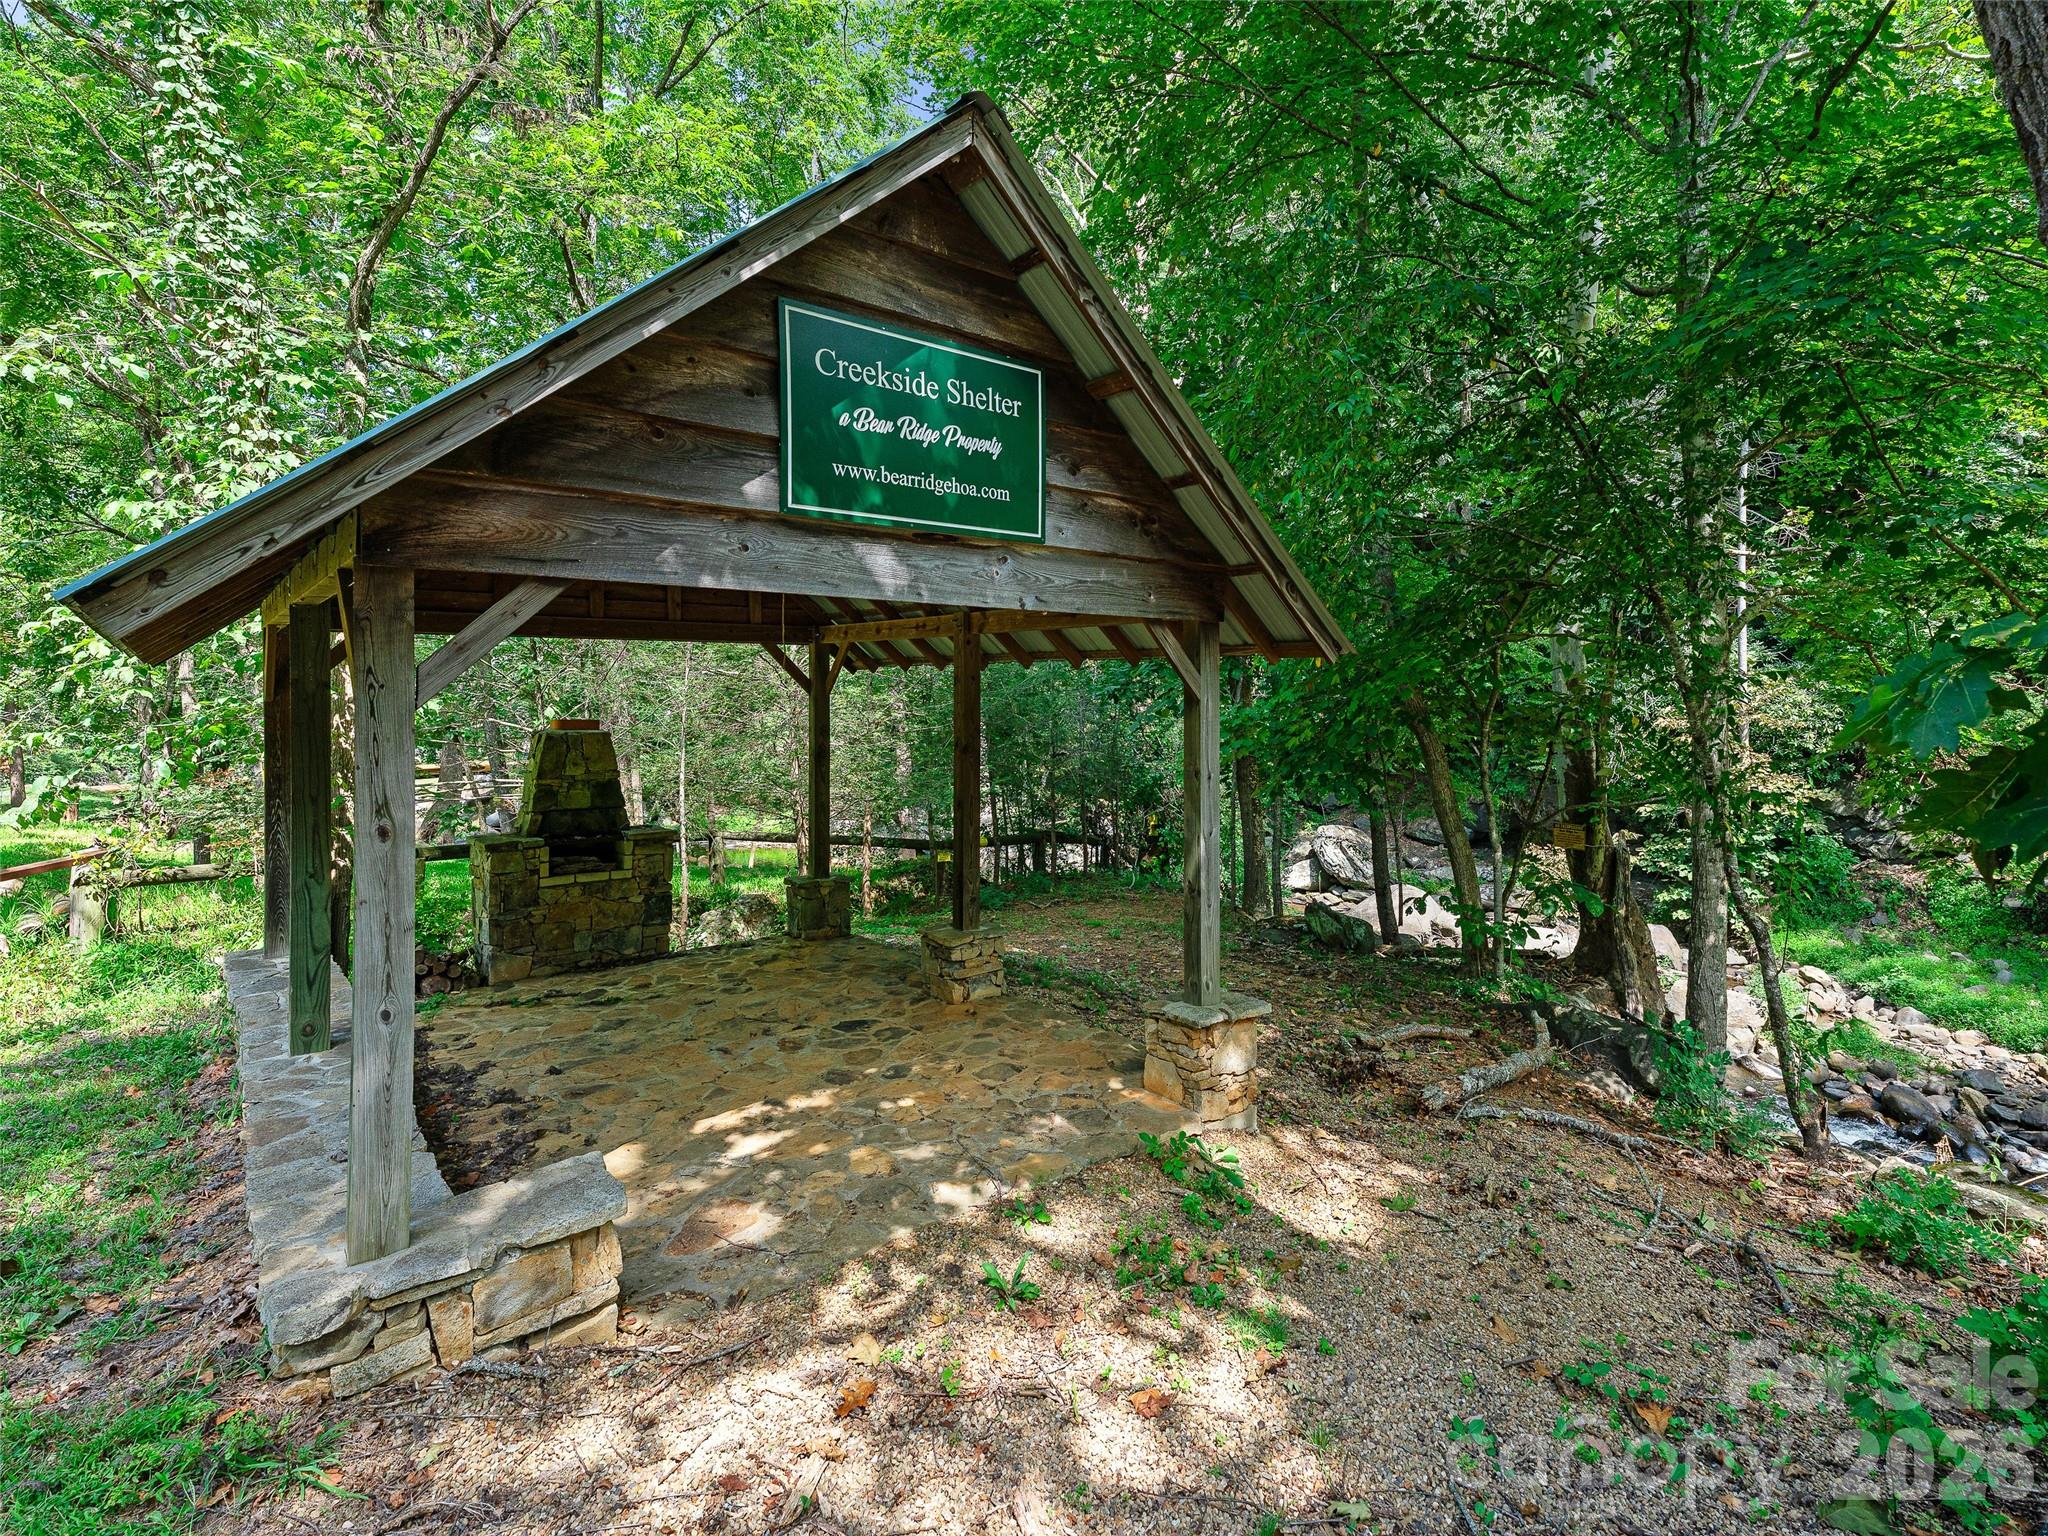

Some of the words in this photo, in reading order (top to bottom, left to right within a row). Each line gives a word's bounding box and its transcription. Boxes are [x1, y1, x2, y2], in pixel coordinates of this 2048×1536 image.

[814, 348, 939, 400] Creekside
[946, 378, 1022, 418] Shelter
[838, 411, 850, 427] a
[853, 407, 895, 434] Bear
[897, 415, 940, 448] Ridge
[942, 424, 1003, 460] Property
[832, 462, 1010, 502] www.bearridgehoa.com
